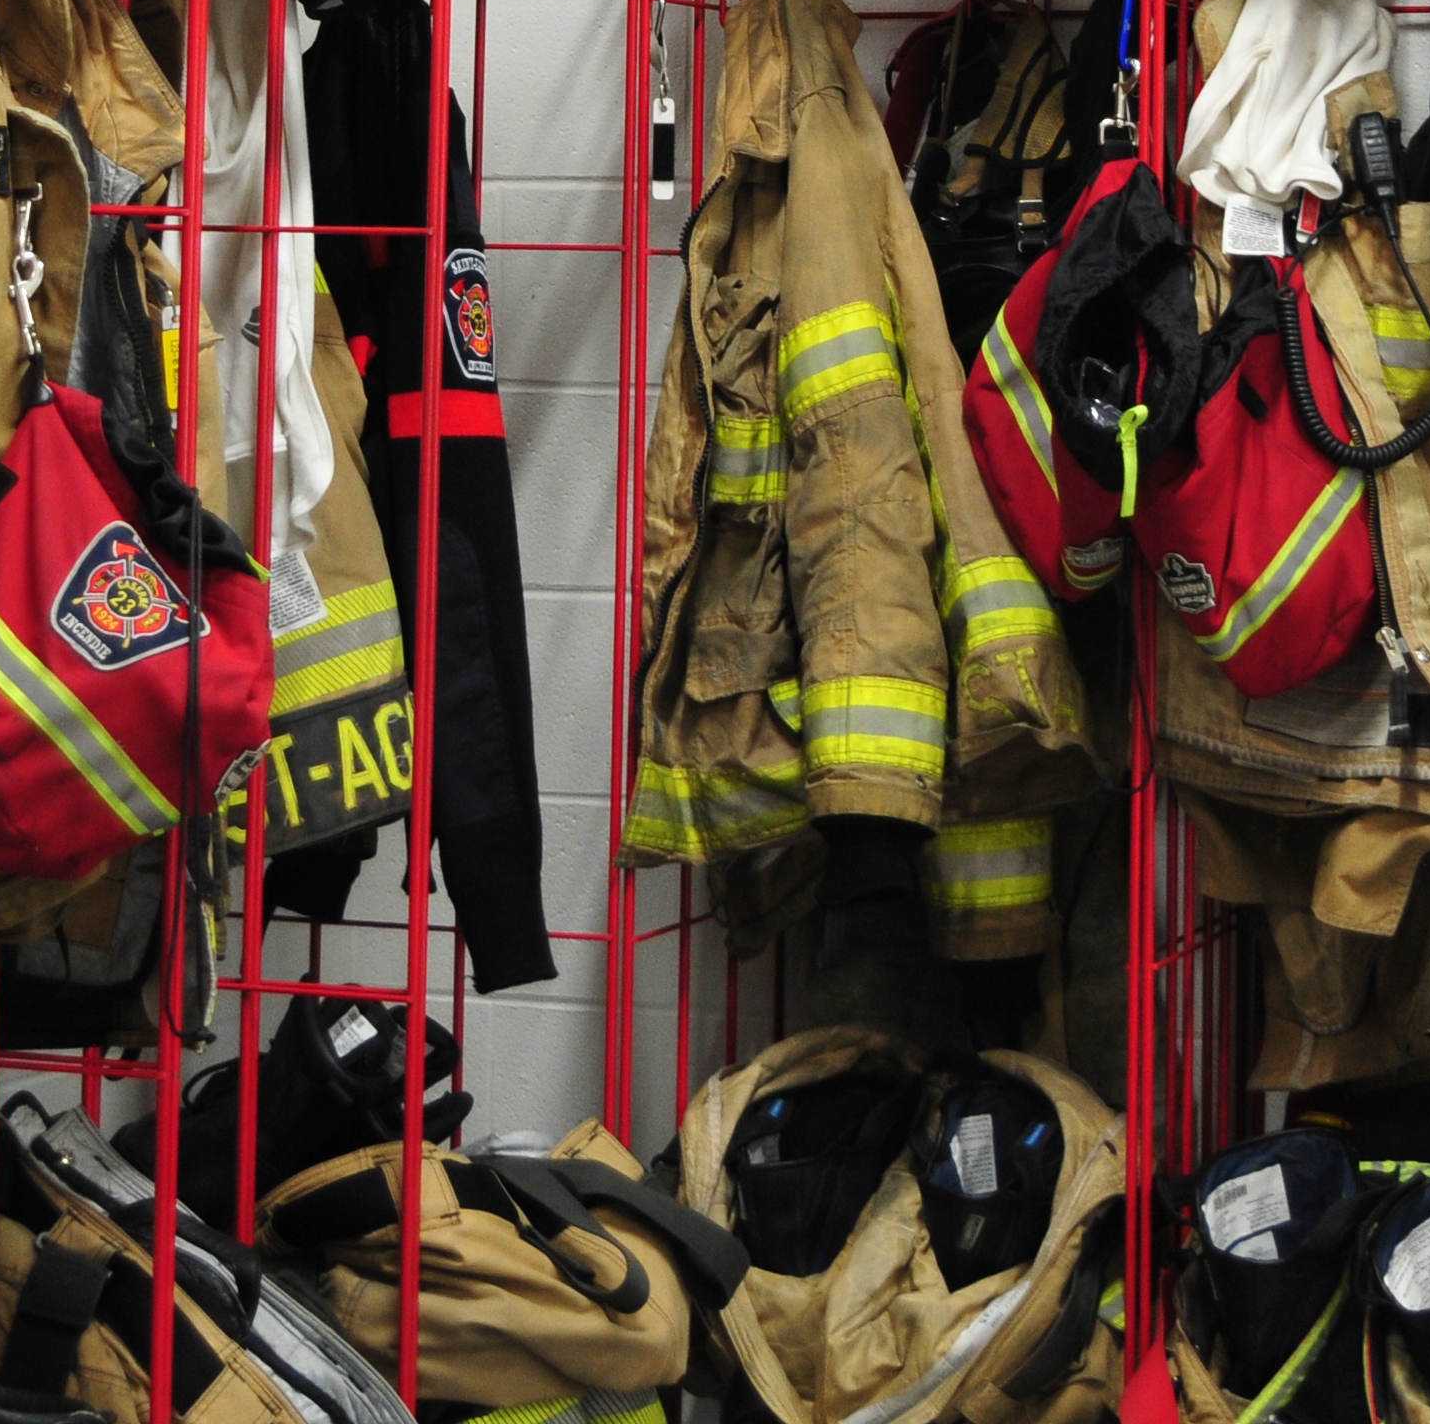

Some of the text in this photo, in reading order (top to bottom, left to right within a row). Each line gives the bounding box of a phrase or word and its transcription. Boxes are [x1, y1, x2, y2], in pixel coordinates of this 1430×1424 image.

[109, 591, 136, 615] 23
[92, 606, 119, 630] 1924
[60, 612, 112, 661] INCENDIE
